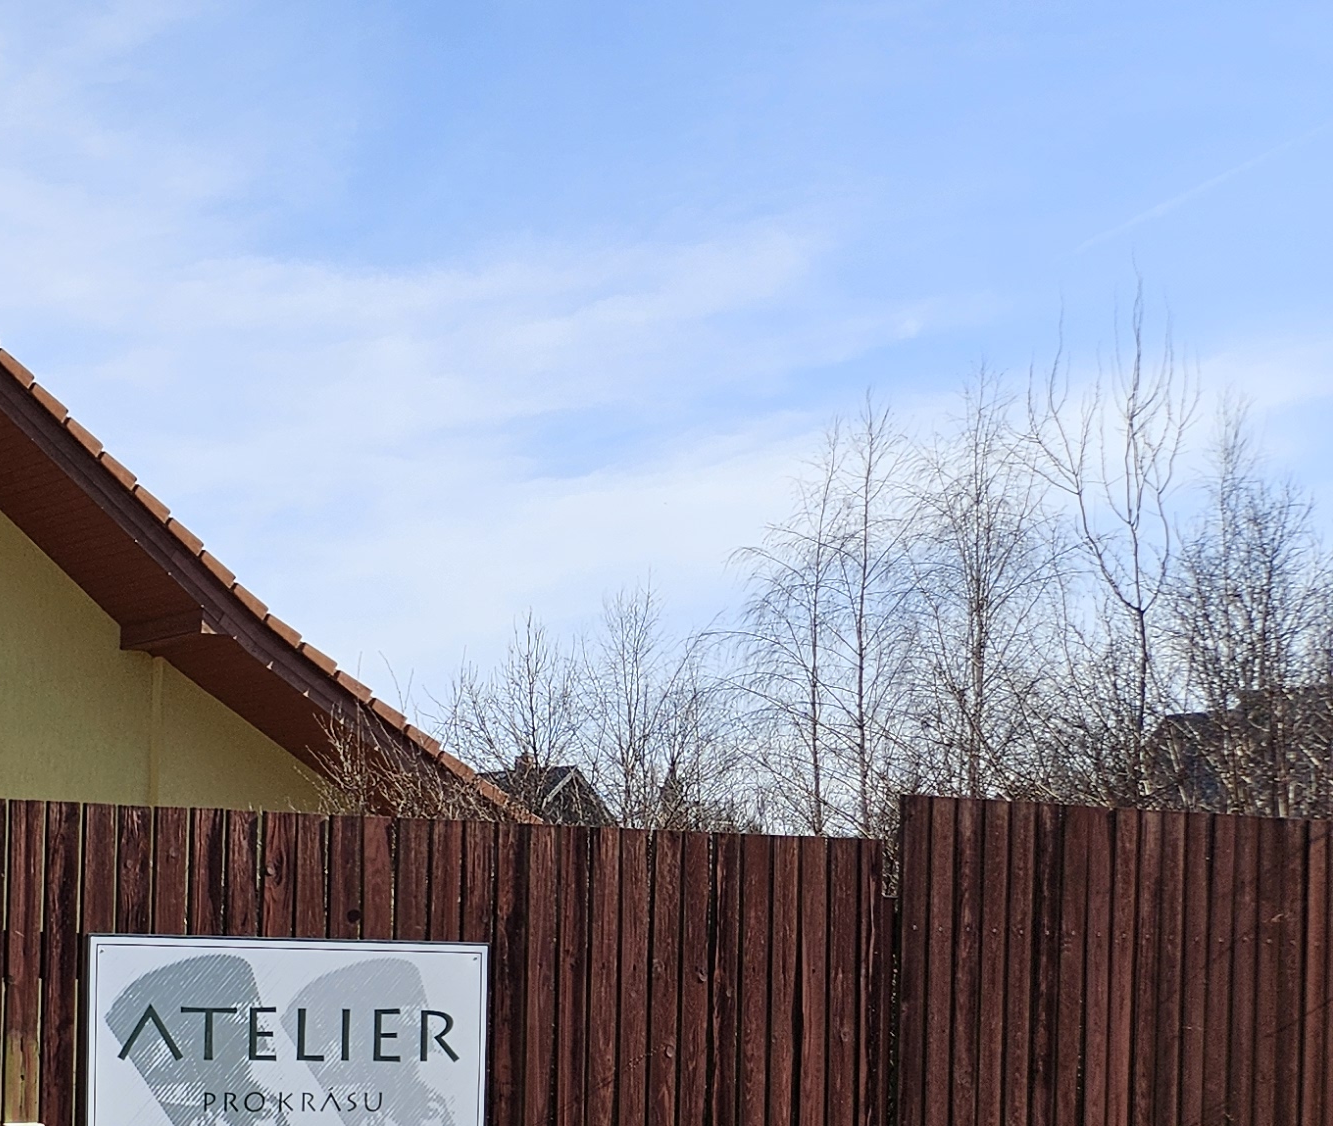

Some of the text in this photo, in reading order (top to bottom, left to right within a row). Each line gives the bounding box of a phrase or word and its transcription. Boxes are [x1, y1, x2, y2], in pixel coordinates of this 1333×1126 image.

[118, 1003, 460, 1063] ATELIER
[203, 1086, 384, 1113] PRO KRÁSU
